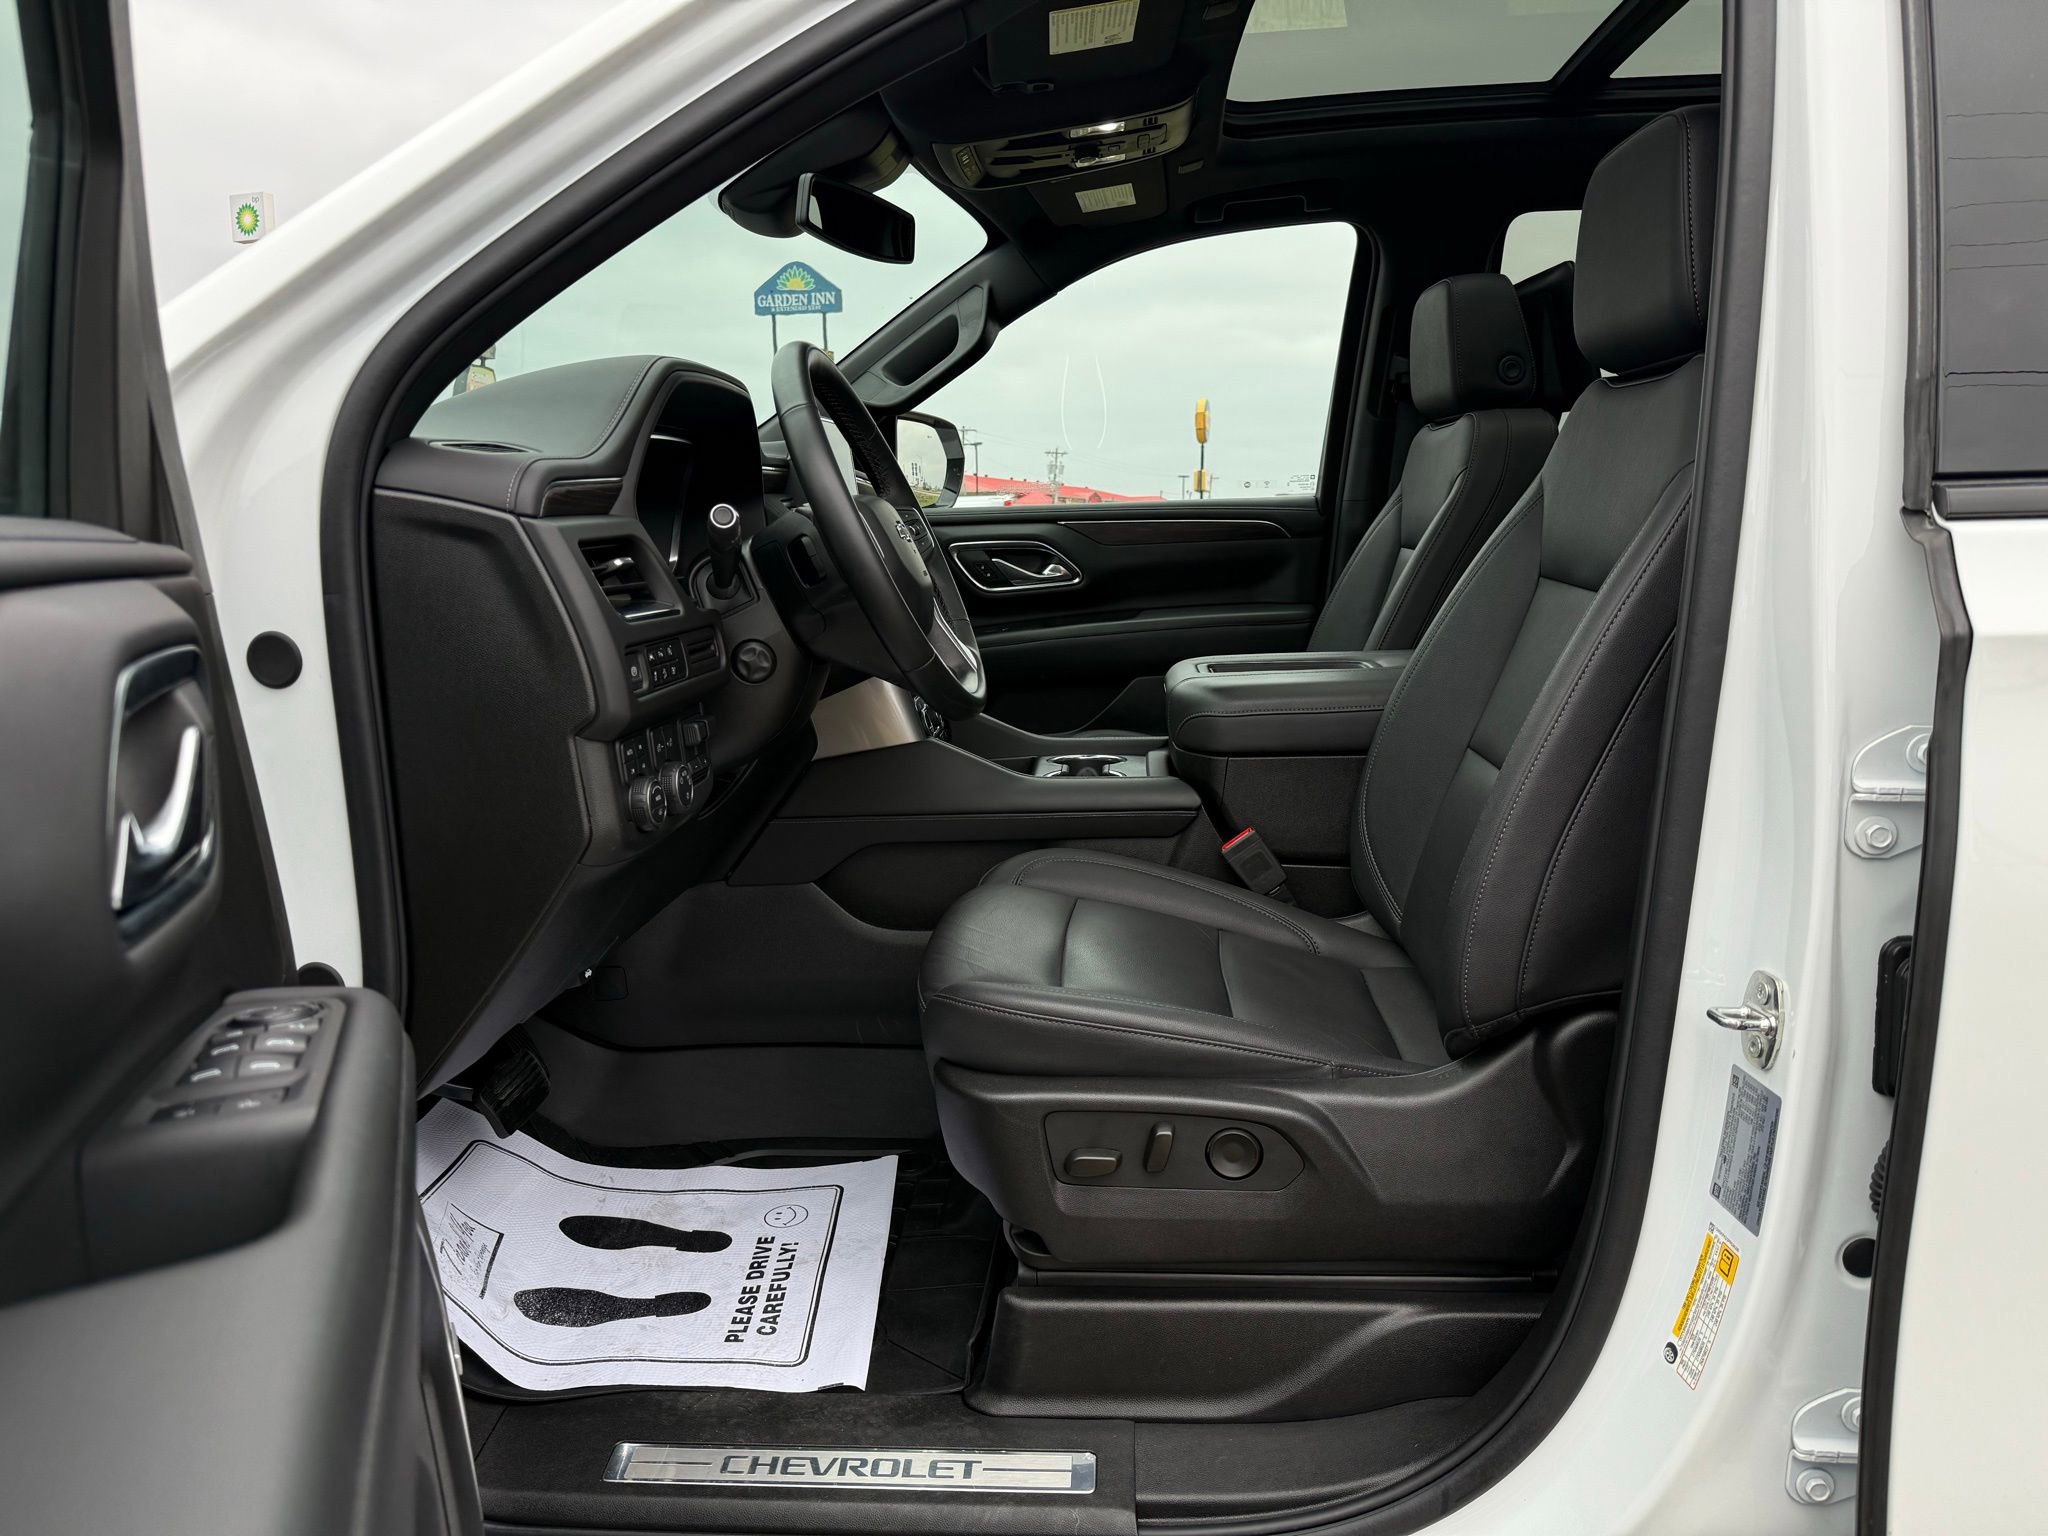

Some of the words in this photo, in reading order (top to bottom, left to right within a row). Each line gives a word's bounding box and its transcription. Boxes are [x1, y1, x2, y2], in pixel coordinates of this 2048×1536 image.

[757, 293, 808, 307] GARDEN
[811, 291, 836, 305] INN
[724, 1284, 761, 1342] PLEASE
[745, 1236, 776, 1280] DRIVE
[756, 1242, 799, 1336] CAREFULLY!
[719, 1455, 983, 1480] CHEVROLET
